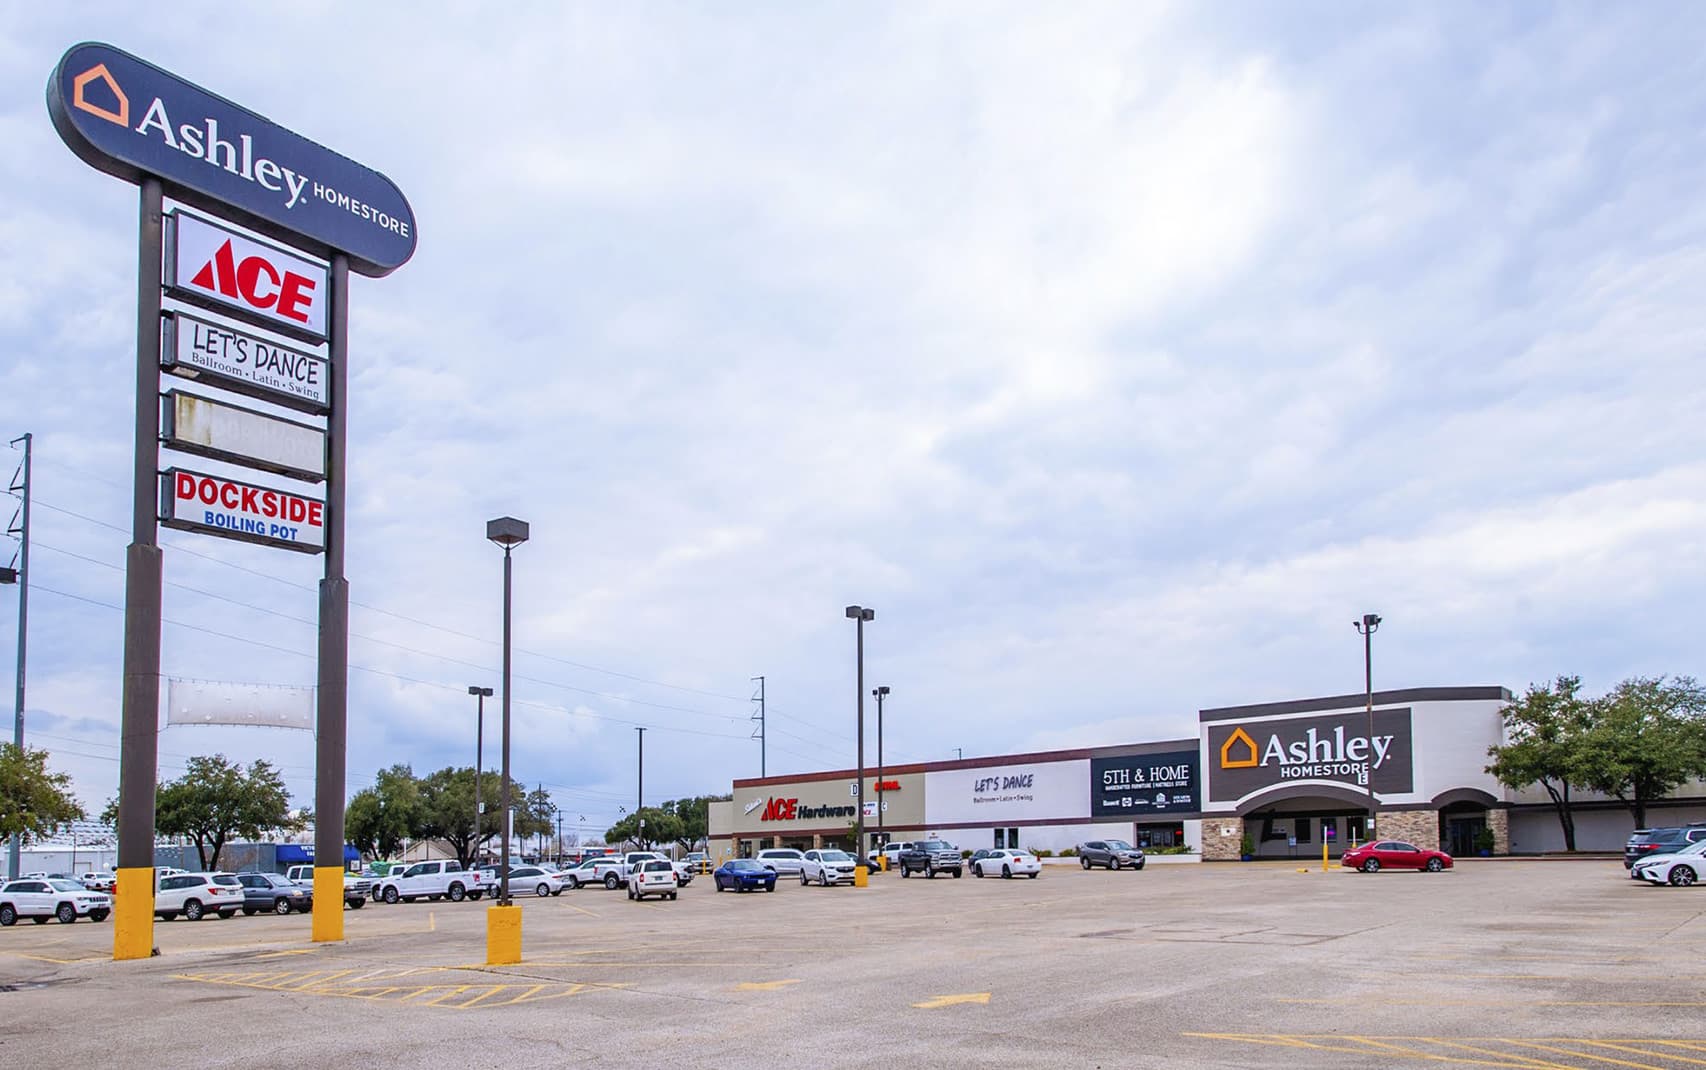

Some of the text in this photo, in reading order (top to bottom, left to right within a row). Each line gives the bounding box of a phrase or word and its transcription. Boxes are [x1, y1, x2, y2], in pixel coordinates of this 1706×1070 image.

[313, 182, 410, 239] HOMESTORE
[191, 238, 316, 324] ACE
[194, 324, 319, 385] LET'S DANCE
[192, 351, 320, 401] Ballroom Latin Swing
[177, 473, 323, 528] DOCKSIDE
[204, 510, 298, 541] BOILING POT
[974, 773, 1034, 792] LET'S DANCE
[1103, 764, 1190, 785] 5TH & HOME
[1281, 762, 1369, 778] HOMESTORE
[852, 784, 858, 795] D
[761, 796, 798, 821] ACE
[797, 804, 856, 819] Hardware
